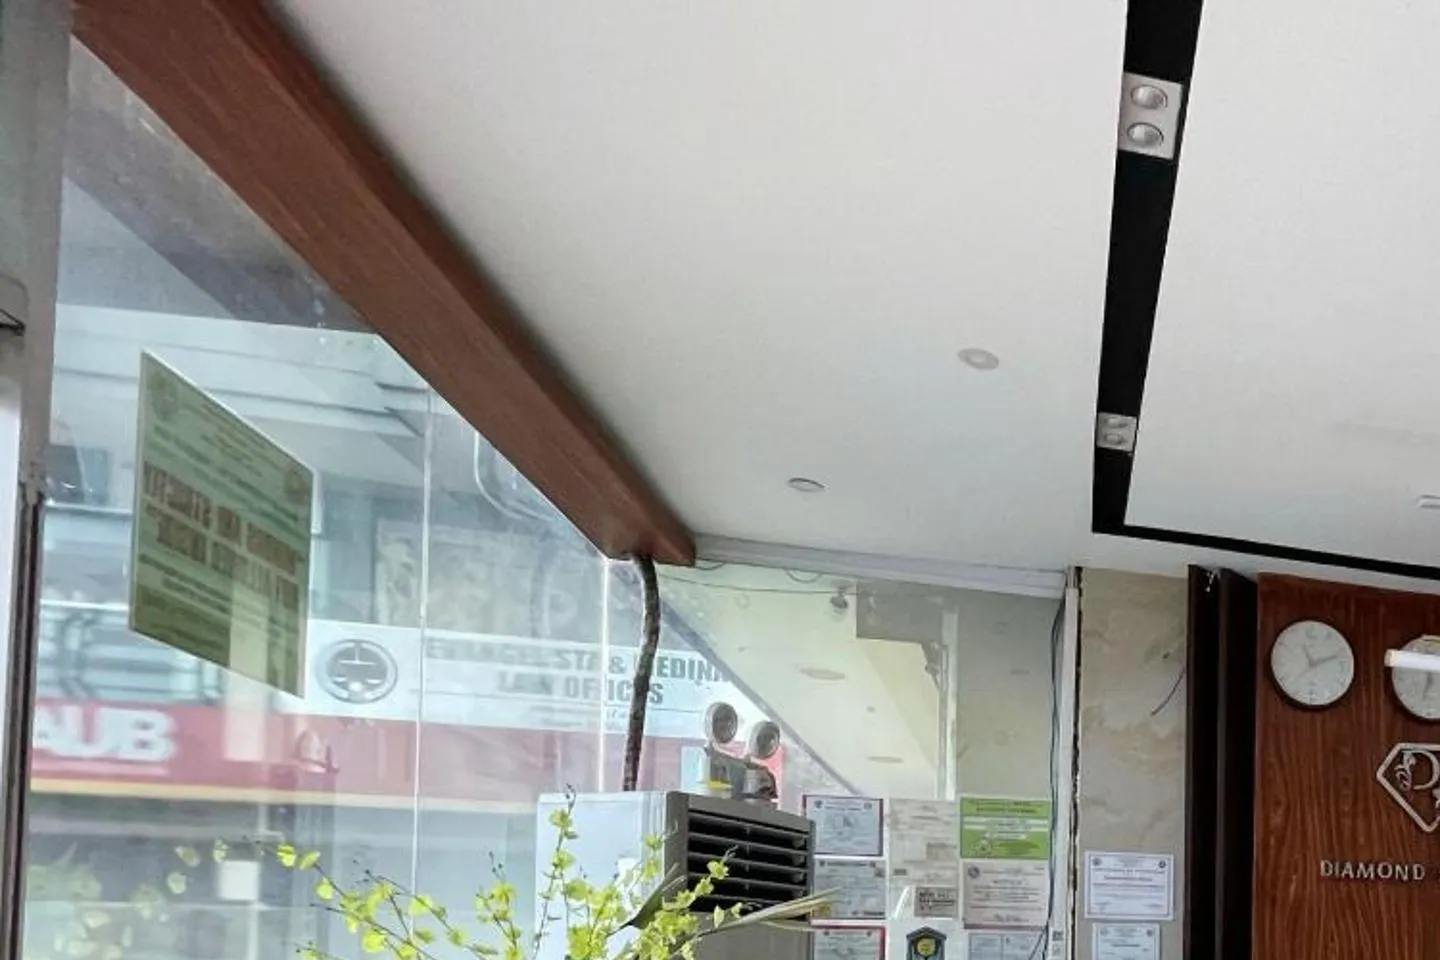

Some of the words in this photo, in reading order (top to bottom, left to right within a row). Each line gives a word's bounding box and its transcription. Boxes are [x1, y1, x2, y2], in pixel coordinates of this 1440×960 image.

[609, 656, 626, 674] &
[634, 655, 724, 682] EDIN
[564, 675, 664, 704] OFICS
[1320, 859, 1426, 881] DIAMOND
